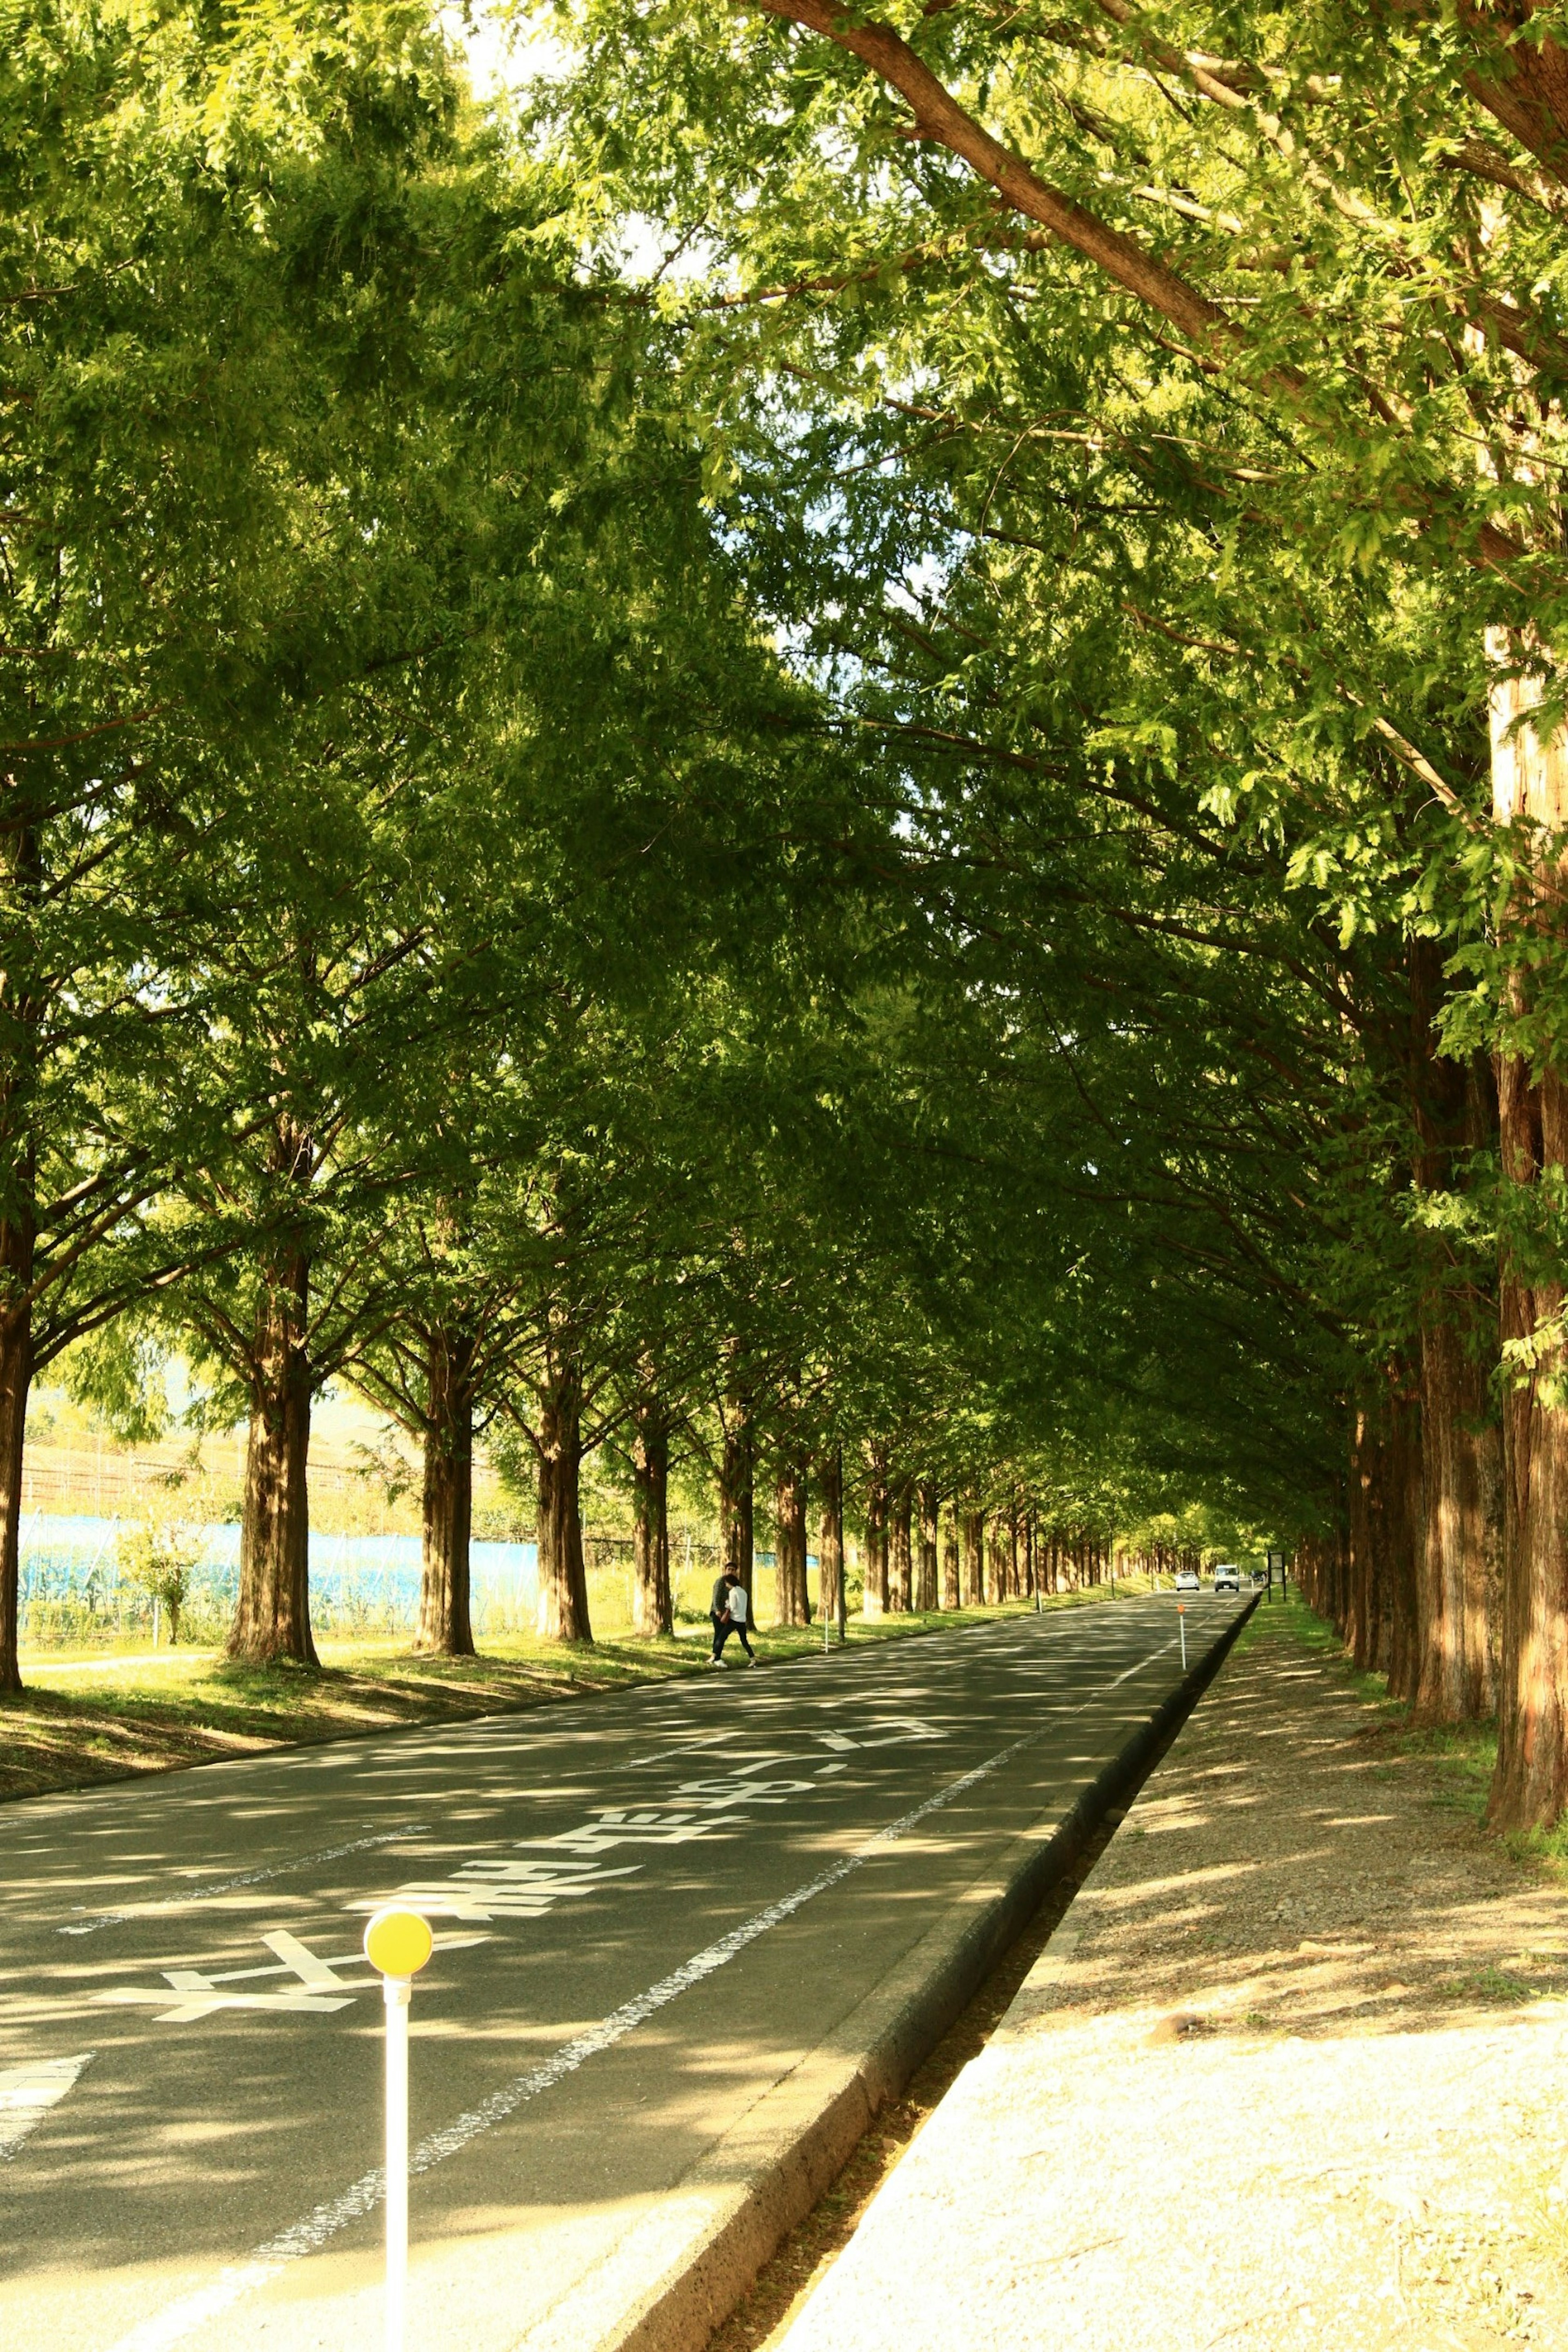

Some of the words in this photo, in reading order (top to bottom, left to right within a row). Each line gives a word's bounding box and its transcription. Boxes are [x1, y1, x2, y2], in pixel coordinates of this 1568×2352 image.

[89, 1754, 849, 2022] 交差点あり
